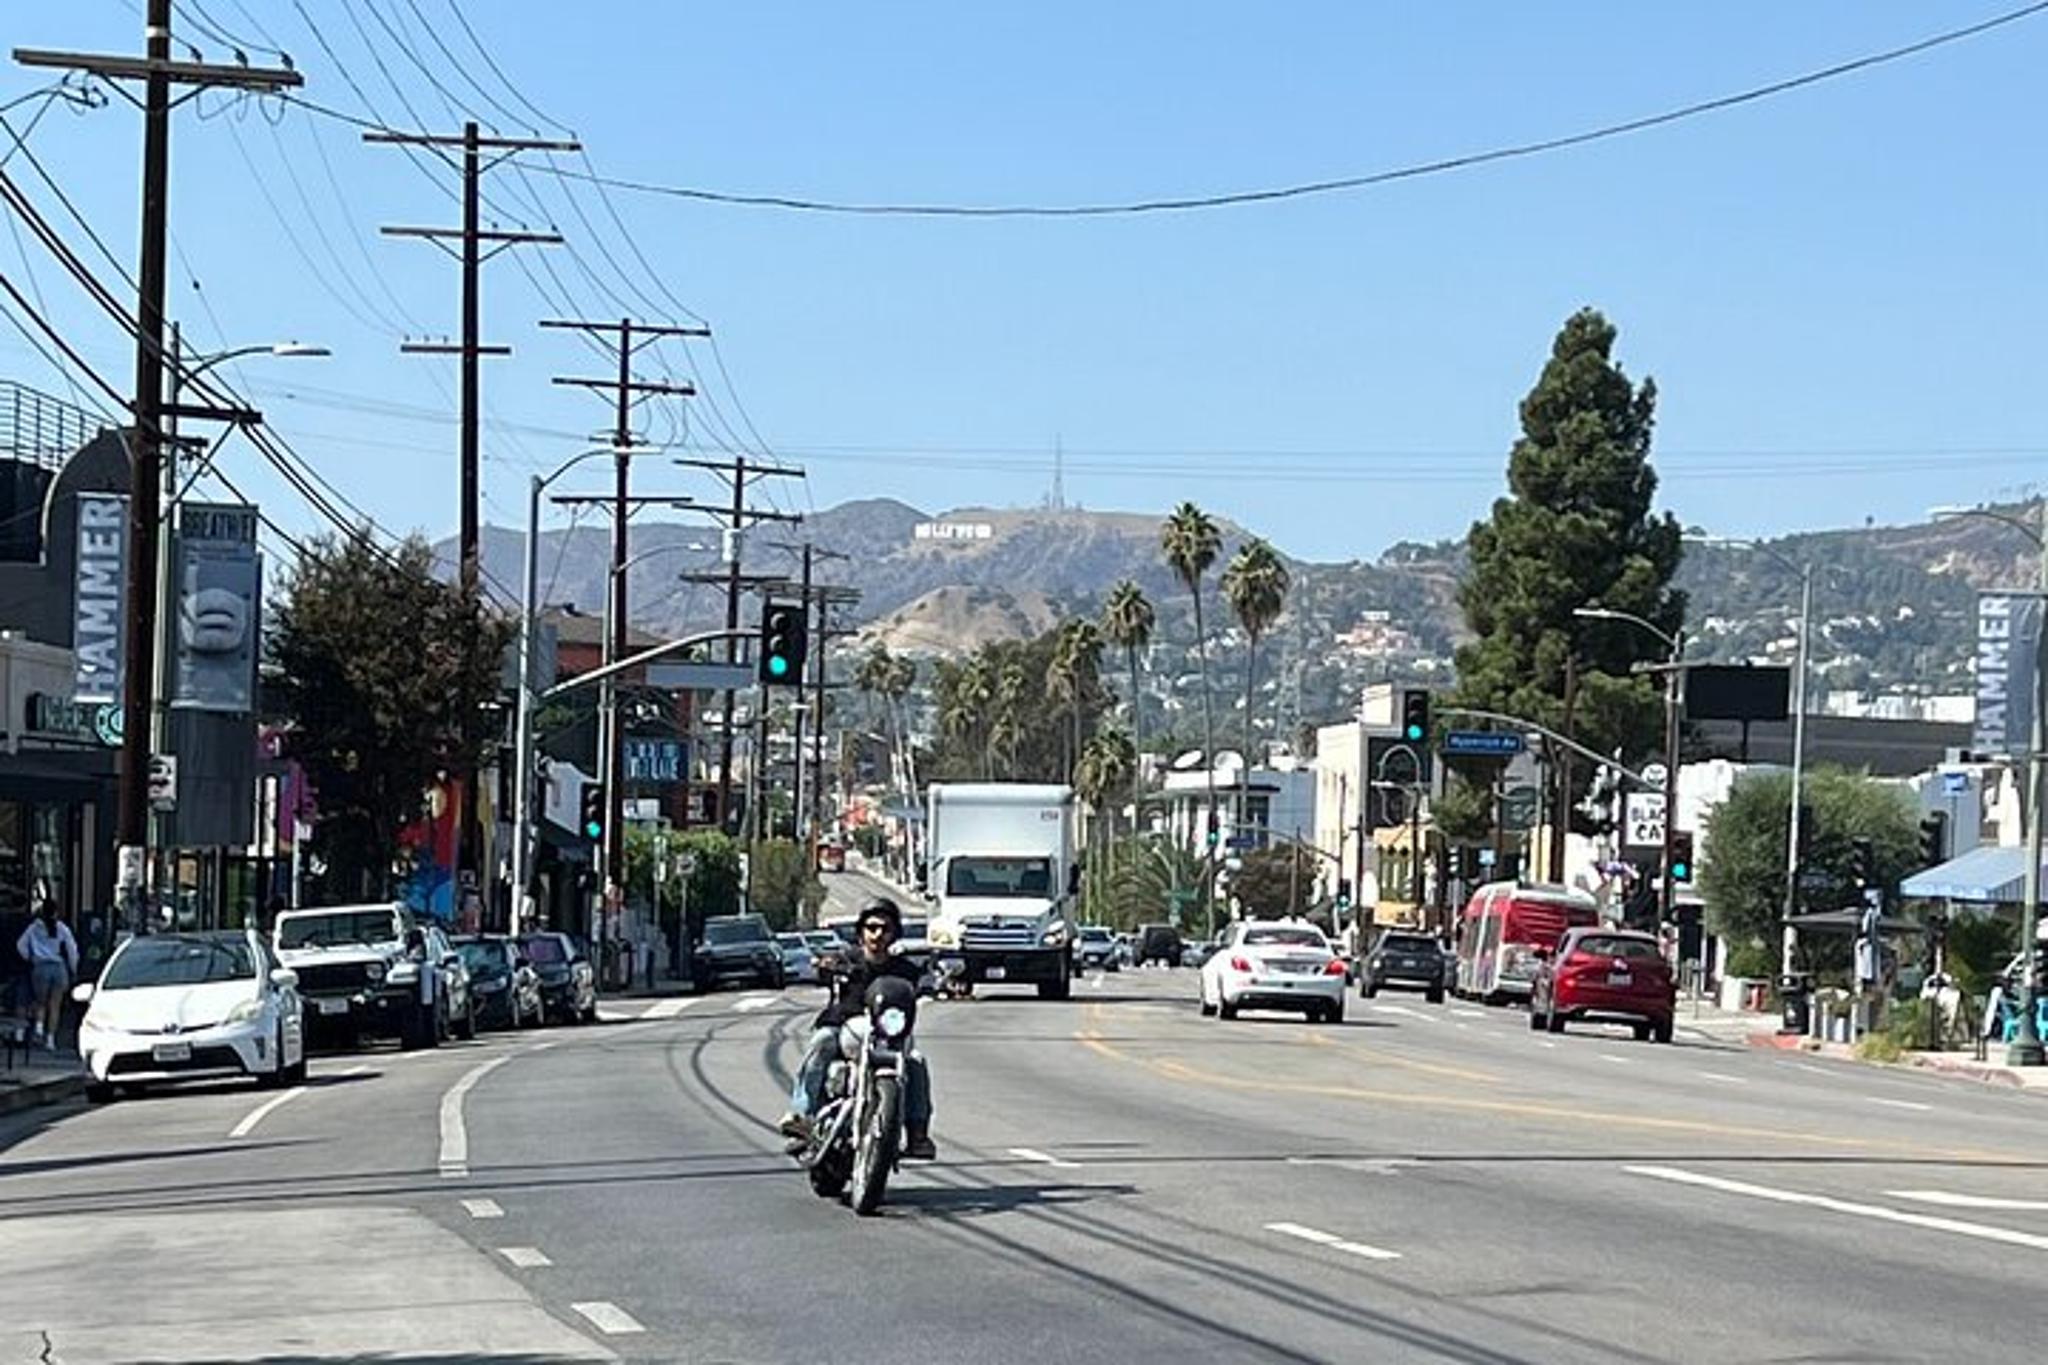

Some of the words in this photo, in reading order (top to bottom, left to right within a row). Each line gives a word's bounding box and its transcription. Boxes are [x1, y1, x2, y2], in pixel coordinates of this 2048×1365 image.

[915, 523, 991, 538] HLLYWD
[77, 499, 122, 696] HAMMER
[1975, 597, 2010, 752] HAMMER
[1630, 806, 1666, 822] BLAC
